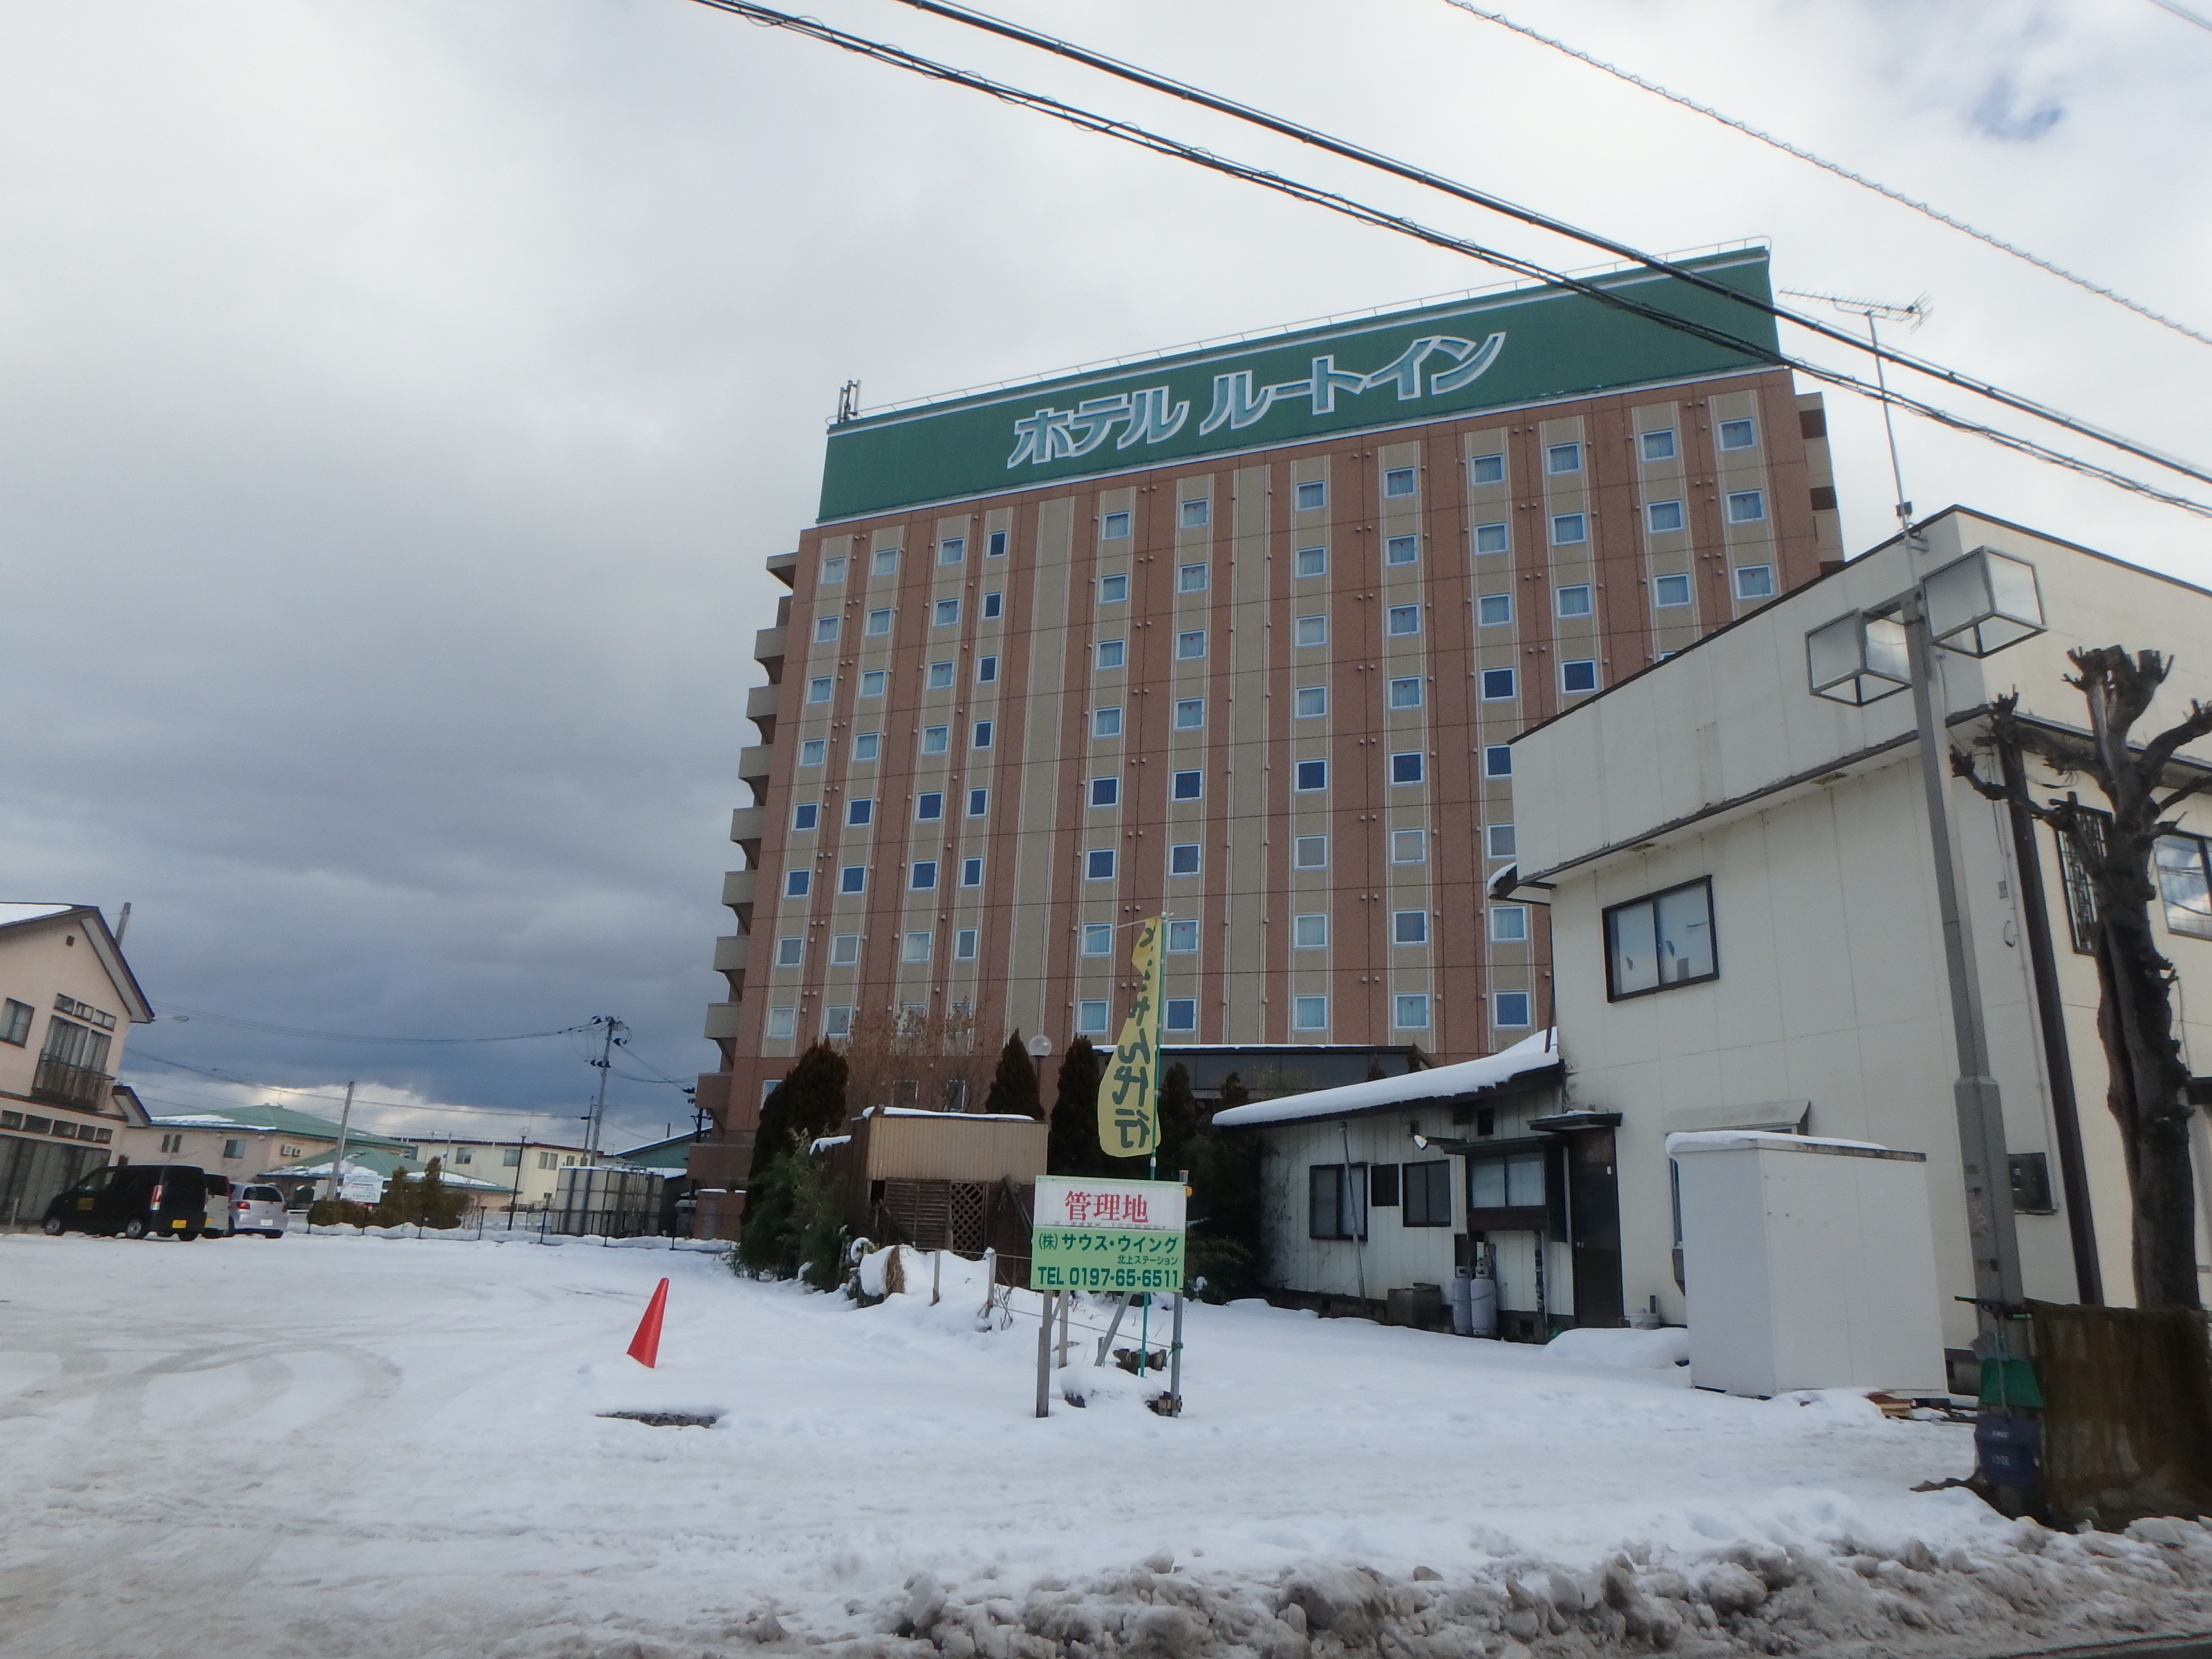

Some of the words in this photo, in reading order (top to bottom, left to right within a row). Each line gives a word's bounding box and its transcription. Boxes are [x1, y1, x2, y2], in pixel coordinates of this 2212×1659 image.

[1006, 385, 1190, 469] ホテル
[1199, 331, 1507, 436] ルートイン
[1065, 1190, 1149, 1223] 管理地
[1117, 1255, 1179, 1266] 北上ステーション
[1038, 1266, 1065, 1285] TEL
[1069, 1267, 1178, 1288] 0197-65-6511
